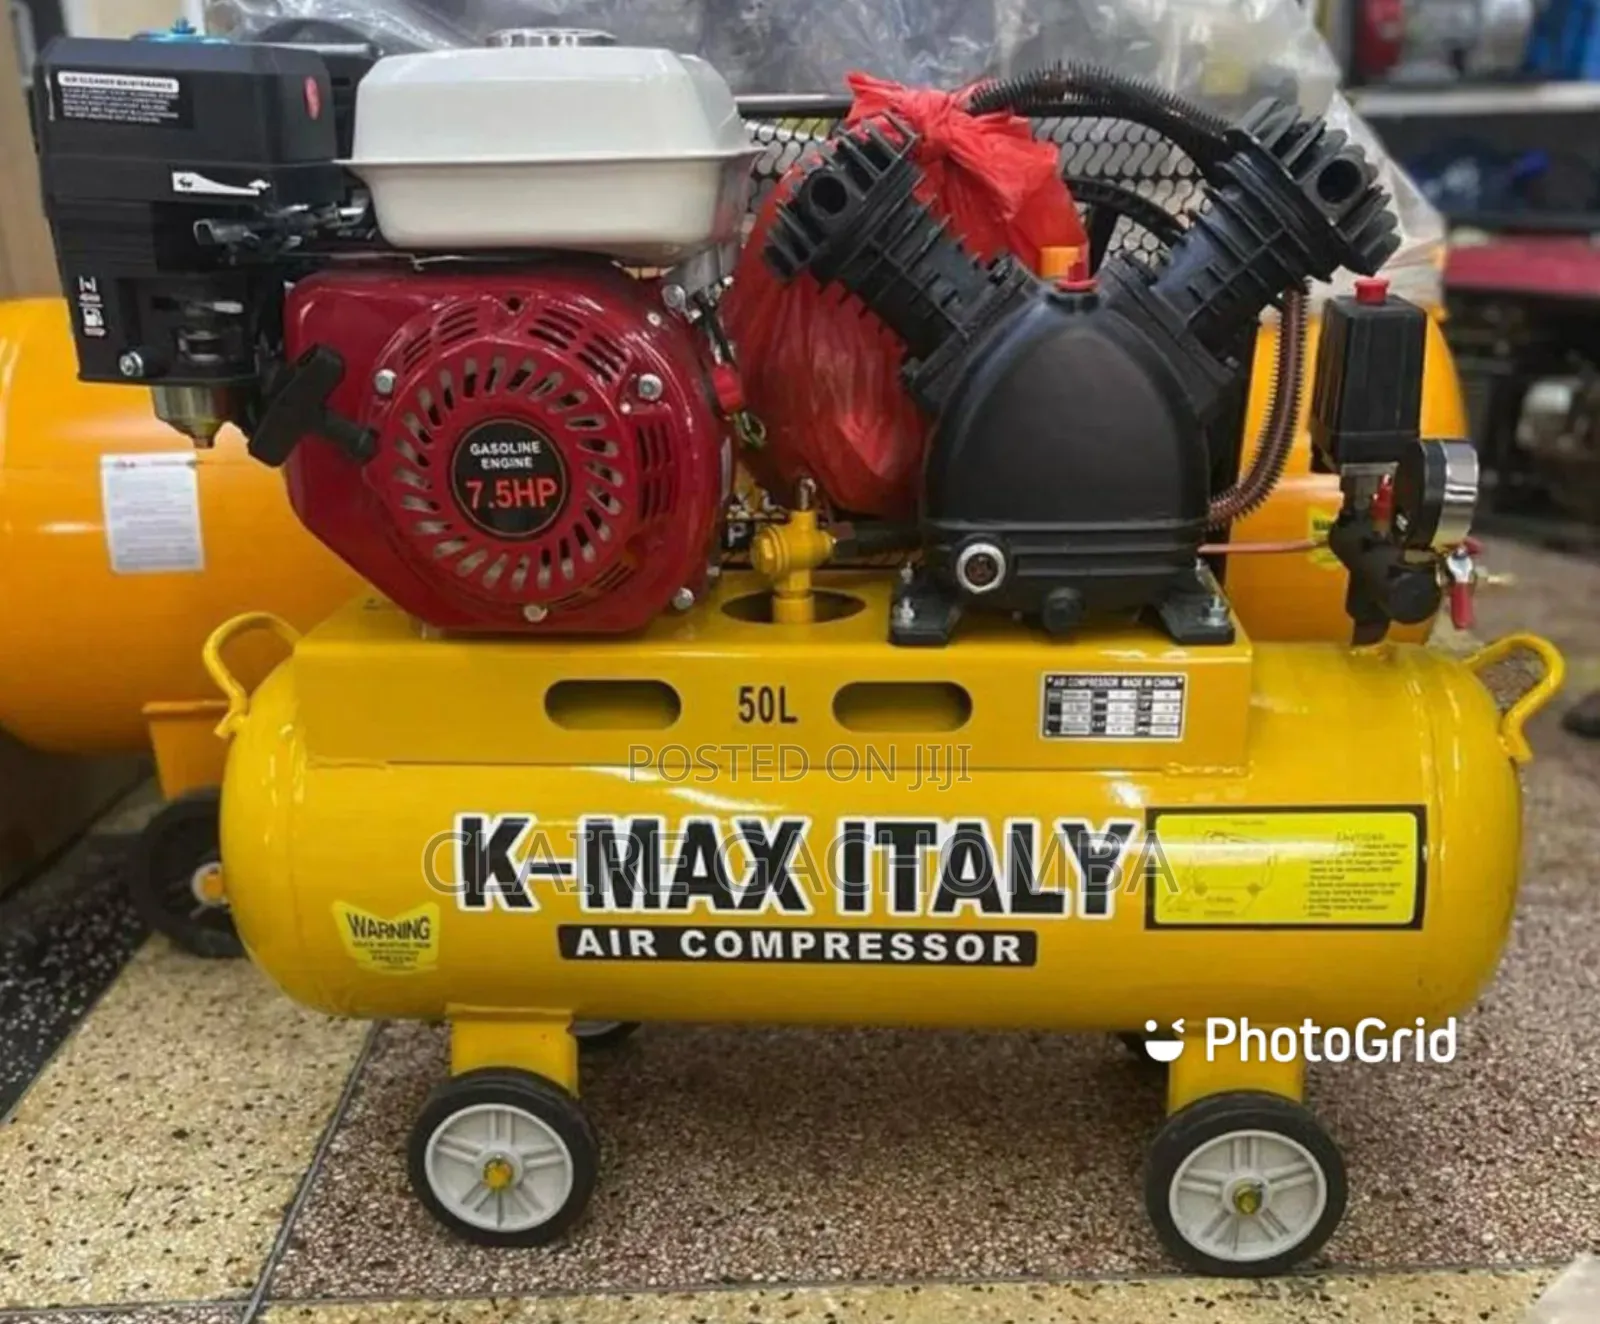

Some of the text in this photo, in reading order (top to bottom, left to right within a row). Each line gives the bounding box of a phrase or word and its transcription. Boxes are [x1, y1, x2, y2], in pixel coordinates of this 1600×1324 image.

[469, 441, 541, 456] GASOLINE
[481, 457, 533, 470] ENGINE
[465, 478, 558, 510] 7.5HP
[738, 687, 798, 723] 50L
[454, 813, 1138, 920] K-MAX ITALY
[346, 912, 431, 940] WARNING
[576, 929, 1022, 963] AIR COMPRESSOR
